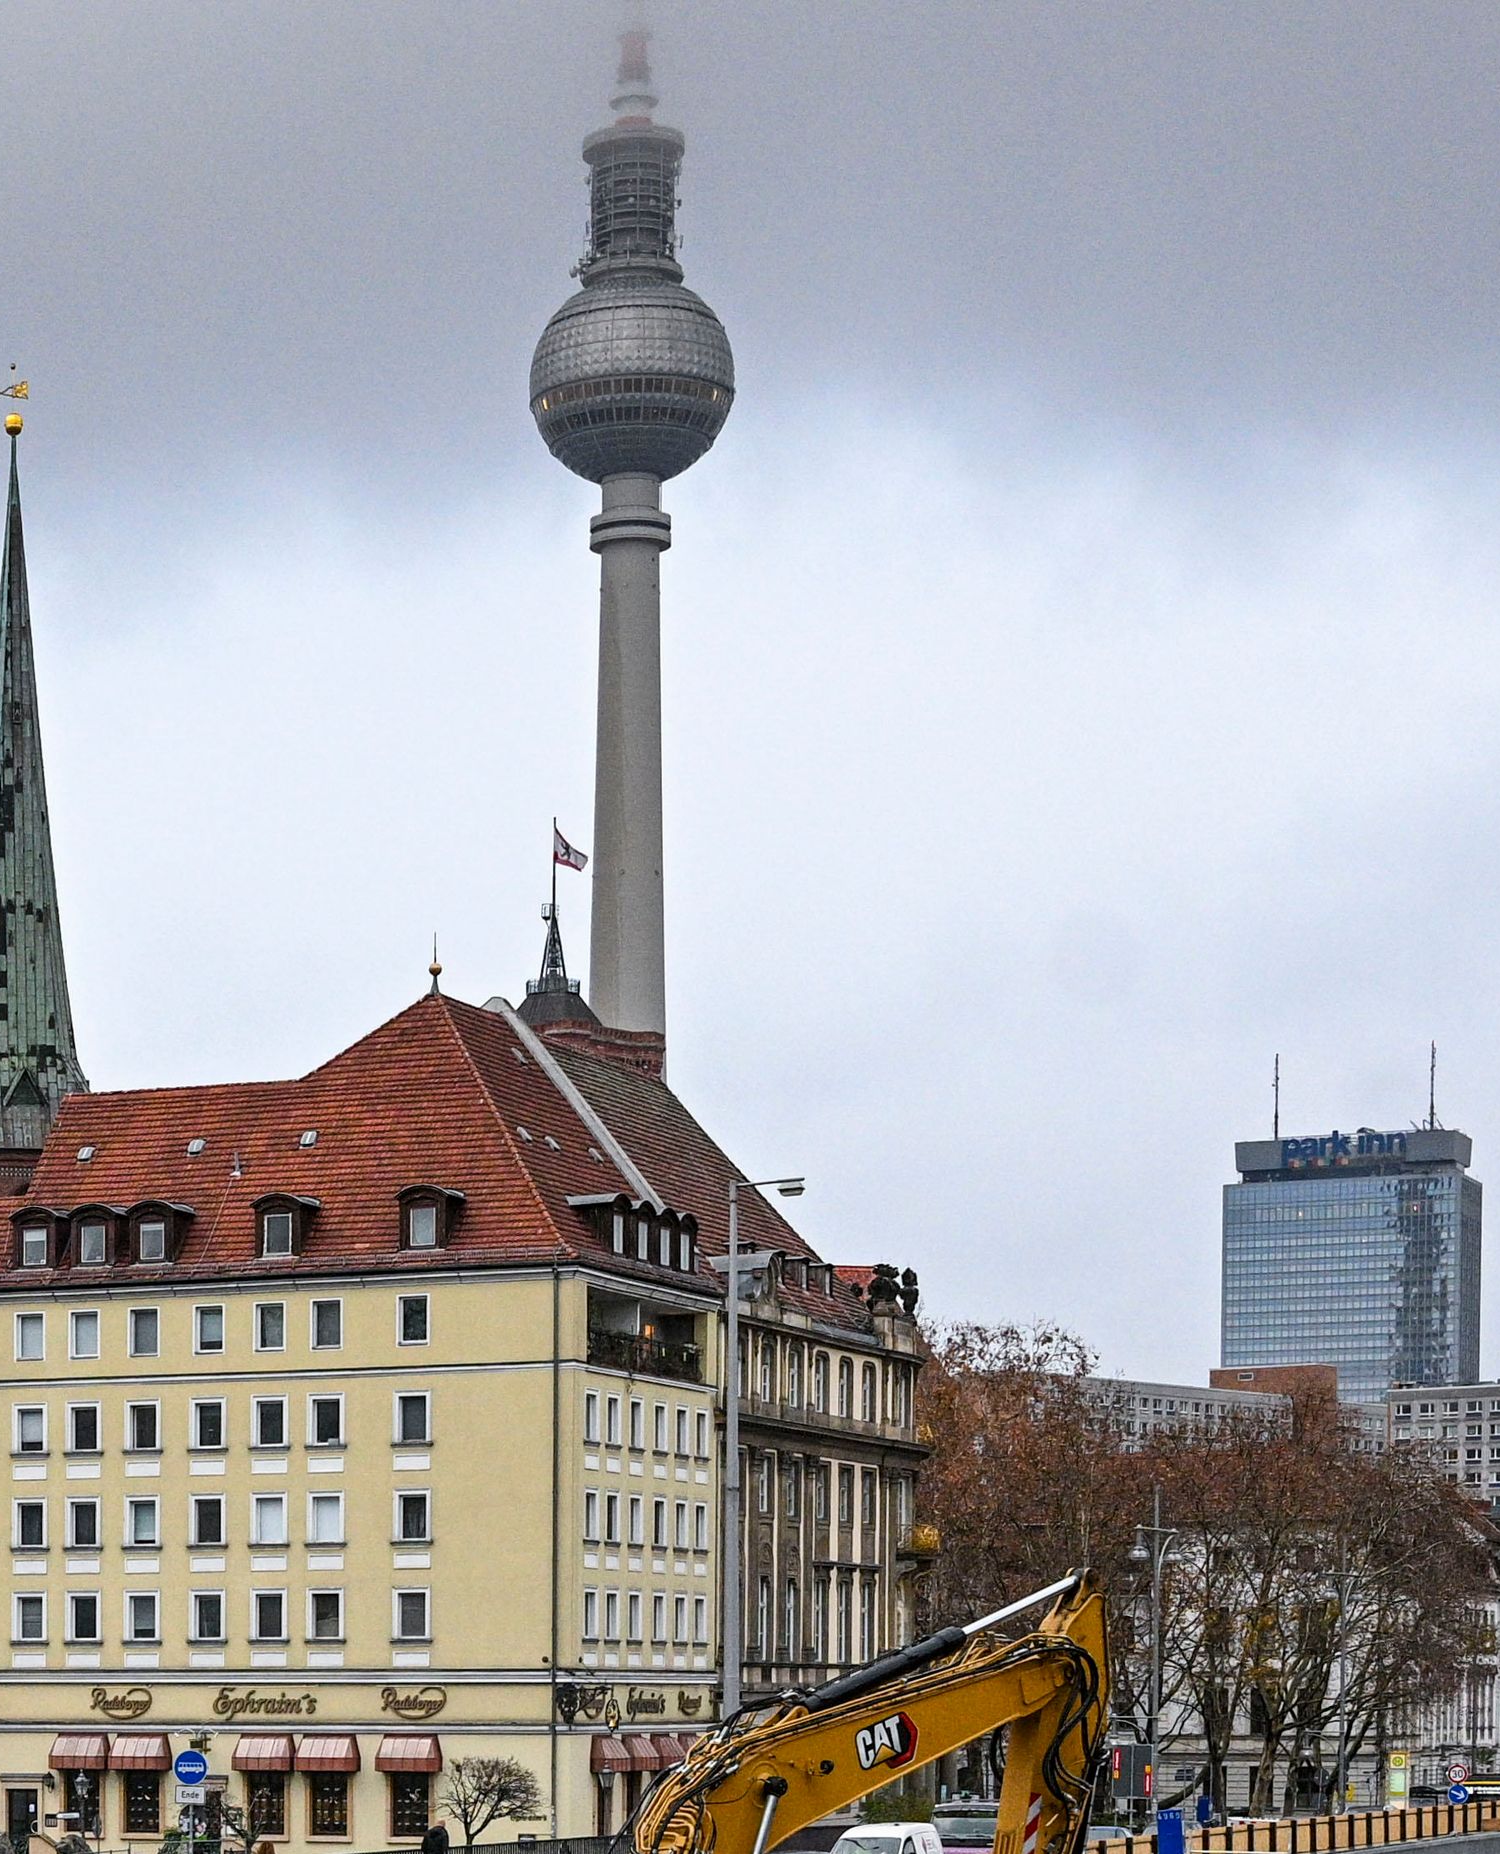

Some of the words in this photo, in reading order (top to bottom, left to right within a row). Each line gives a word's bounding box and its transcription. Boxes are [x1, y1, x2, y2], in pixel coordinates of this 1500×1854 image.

[1282, 1130, 1350, 1168] park
[1357, 1132, 1406, 1155] inn
[90, 1687, 152, 1720] Radeberger
[381, 1686, 447, 1720] Radeberger
[856, 1715, 900, 1769] CAT
[1453, 1769, 1464, 1779] 30
[181, 1790, 200, 1799] Ende
